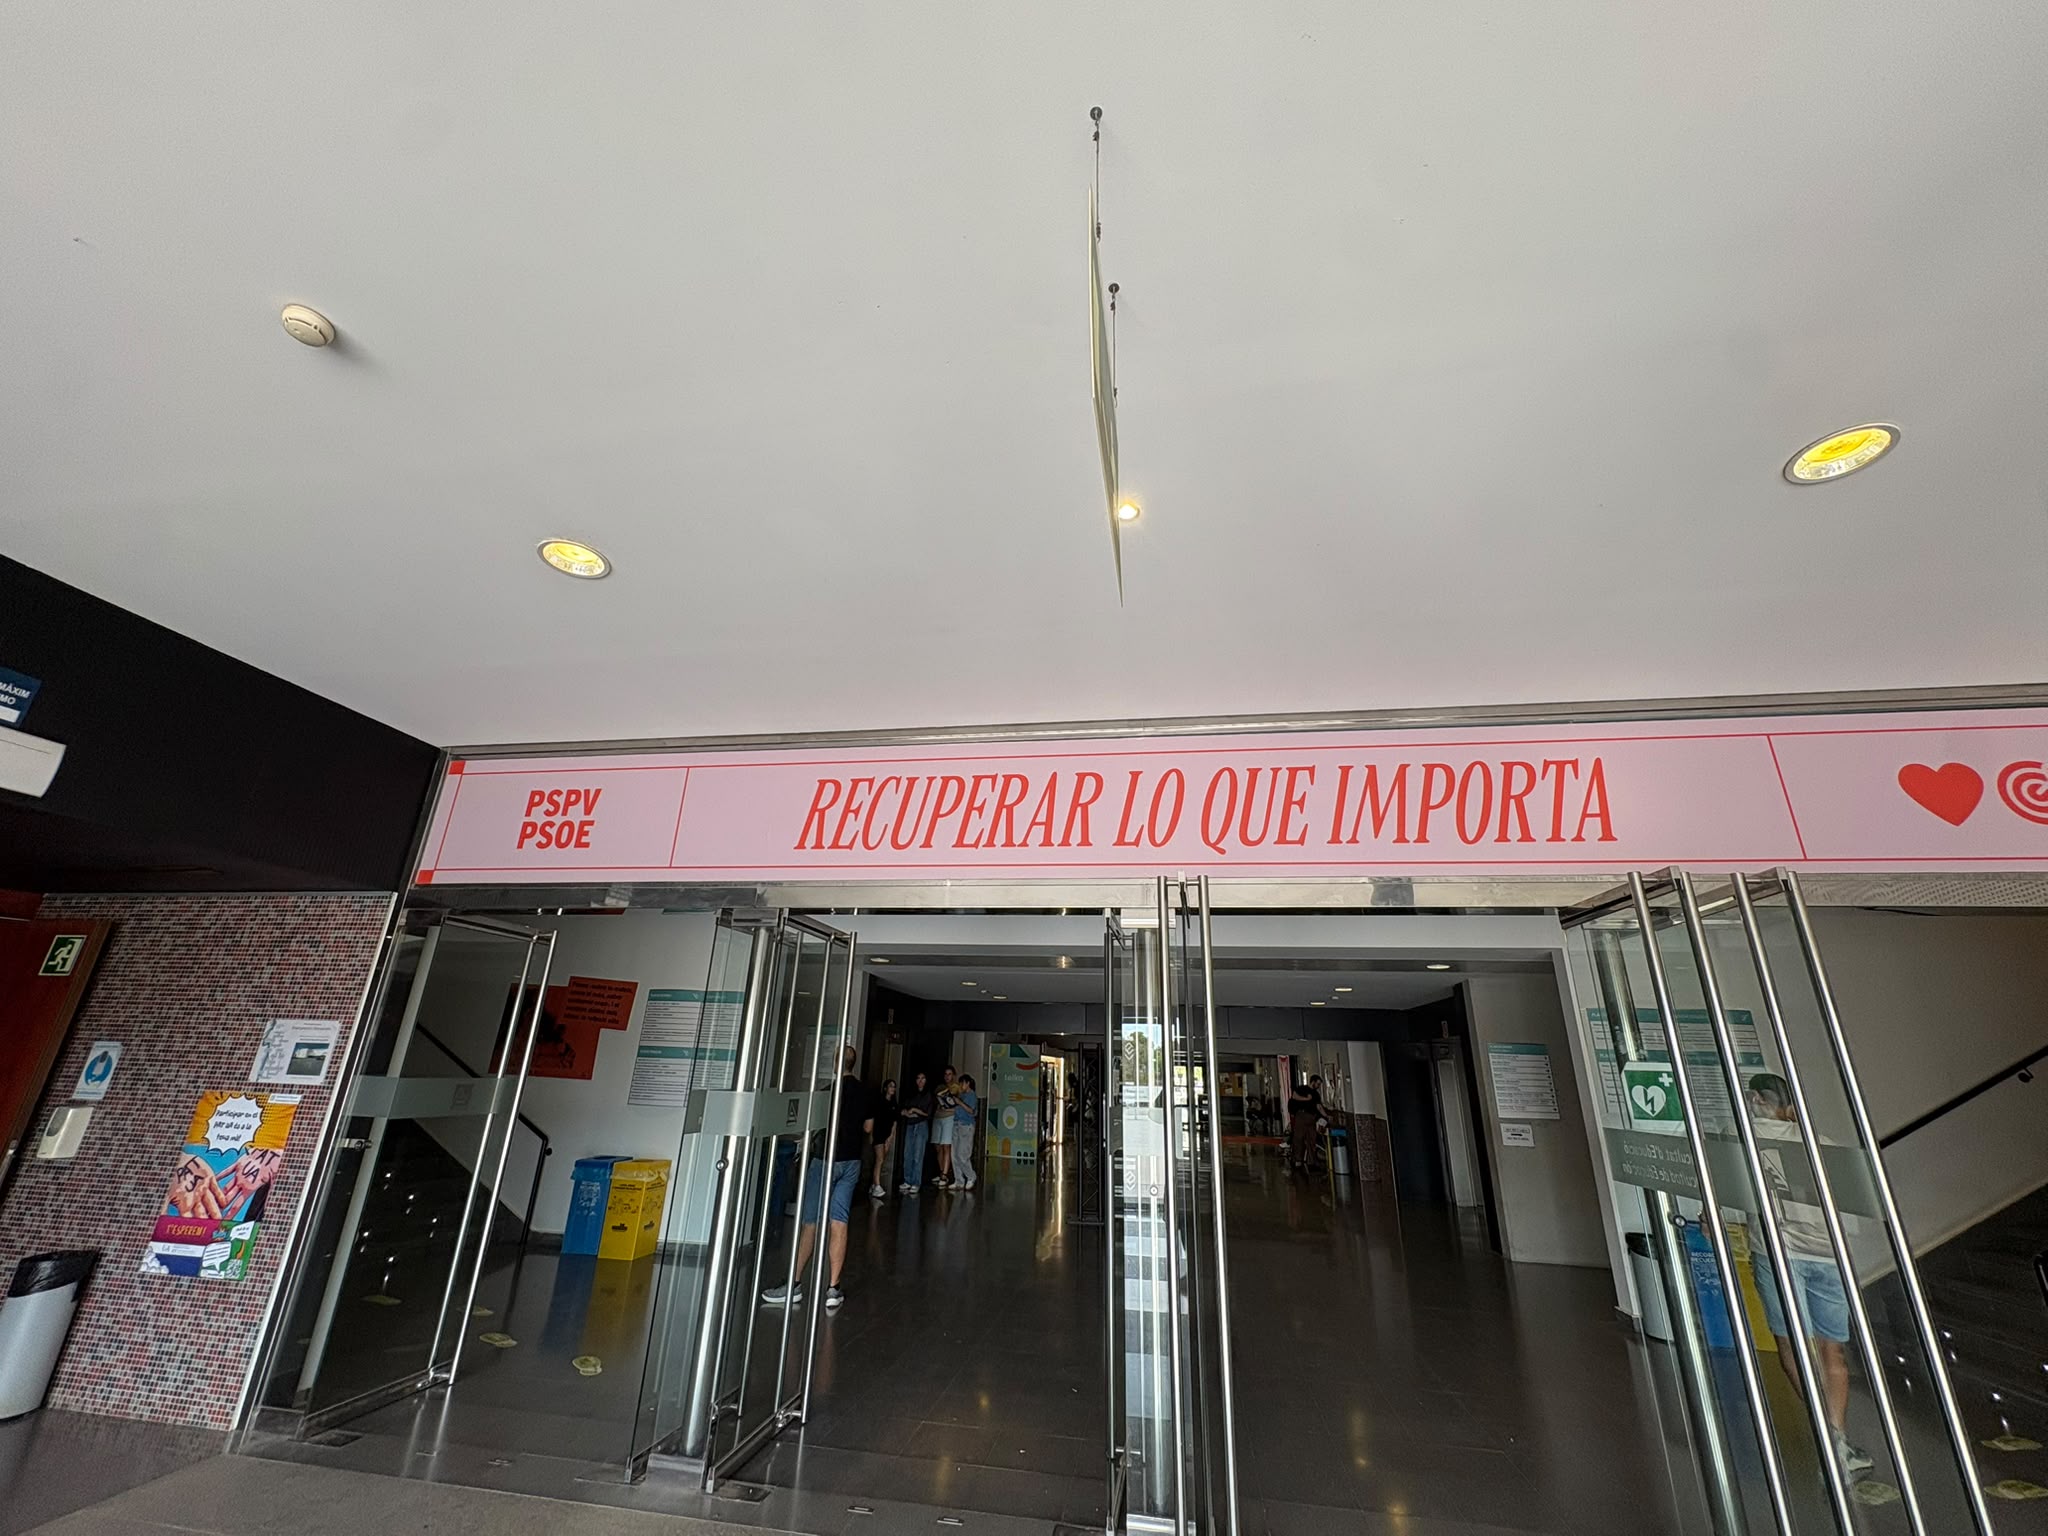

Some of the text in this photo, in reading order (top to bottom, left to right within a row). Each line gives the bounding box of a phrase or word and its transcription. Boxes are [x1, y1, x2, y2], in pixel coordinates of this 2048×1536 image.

[524, 788, 602, 817] PSPV
[795, 757, 1618, 855] RECUPERAR LO QUE IMPORTA
[516, 820, 594, 850] PSOE
